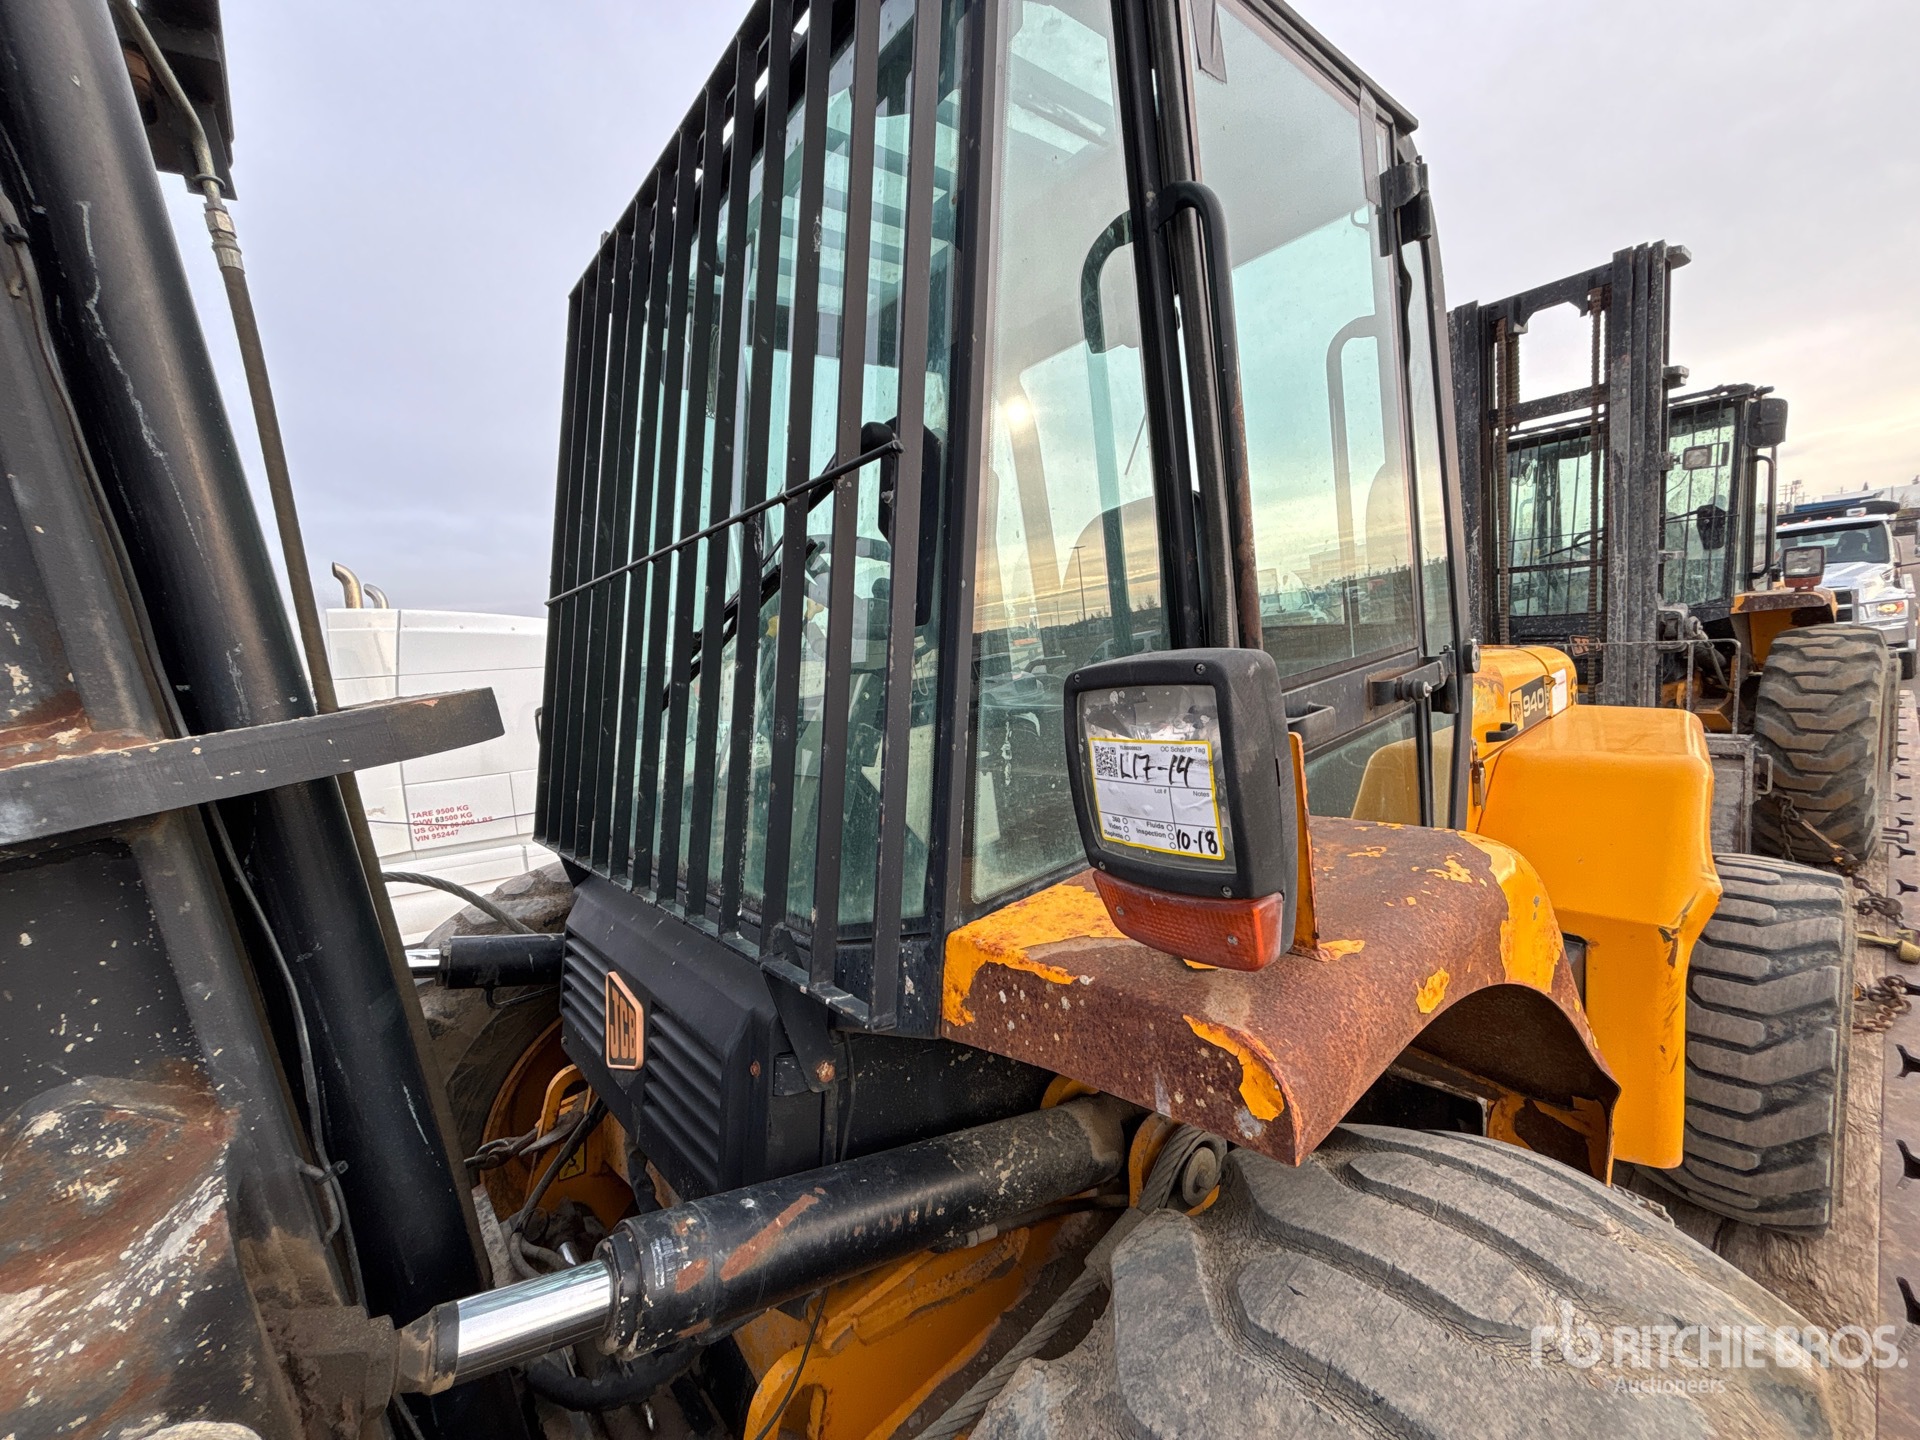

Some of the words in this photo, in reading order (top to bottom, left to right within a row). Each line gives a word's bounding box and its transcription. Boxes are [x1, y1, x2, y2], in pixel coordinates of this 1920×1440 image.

[1523, 687, 1545, 718] 940
[1195, 746, 1206, 754] Tag
[1192, 790, 1210, 798] Notes
[411, 810, 434, 819] TARE
[435, 806, 455, 815] 9500
[456, 804, 470, 812] KG
[412, 818, 433, 827] GVW
[435, 815, 459, 823] 63500
[1107, 822, 1122, 831] Video
[1146, 821, 1165, 830] Fluids
[413, 827, 426, 835] US
[428, 823, 448, 832] GVW
[1135, 828, 1167, 838] Inspection
[414, 834, 430, 842] VIN
[431, 829, 459, 840] 952447
[609, 985, 637, 1060] JCB
